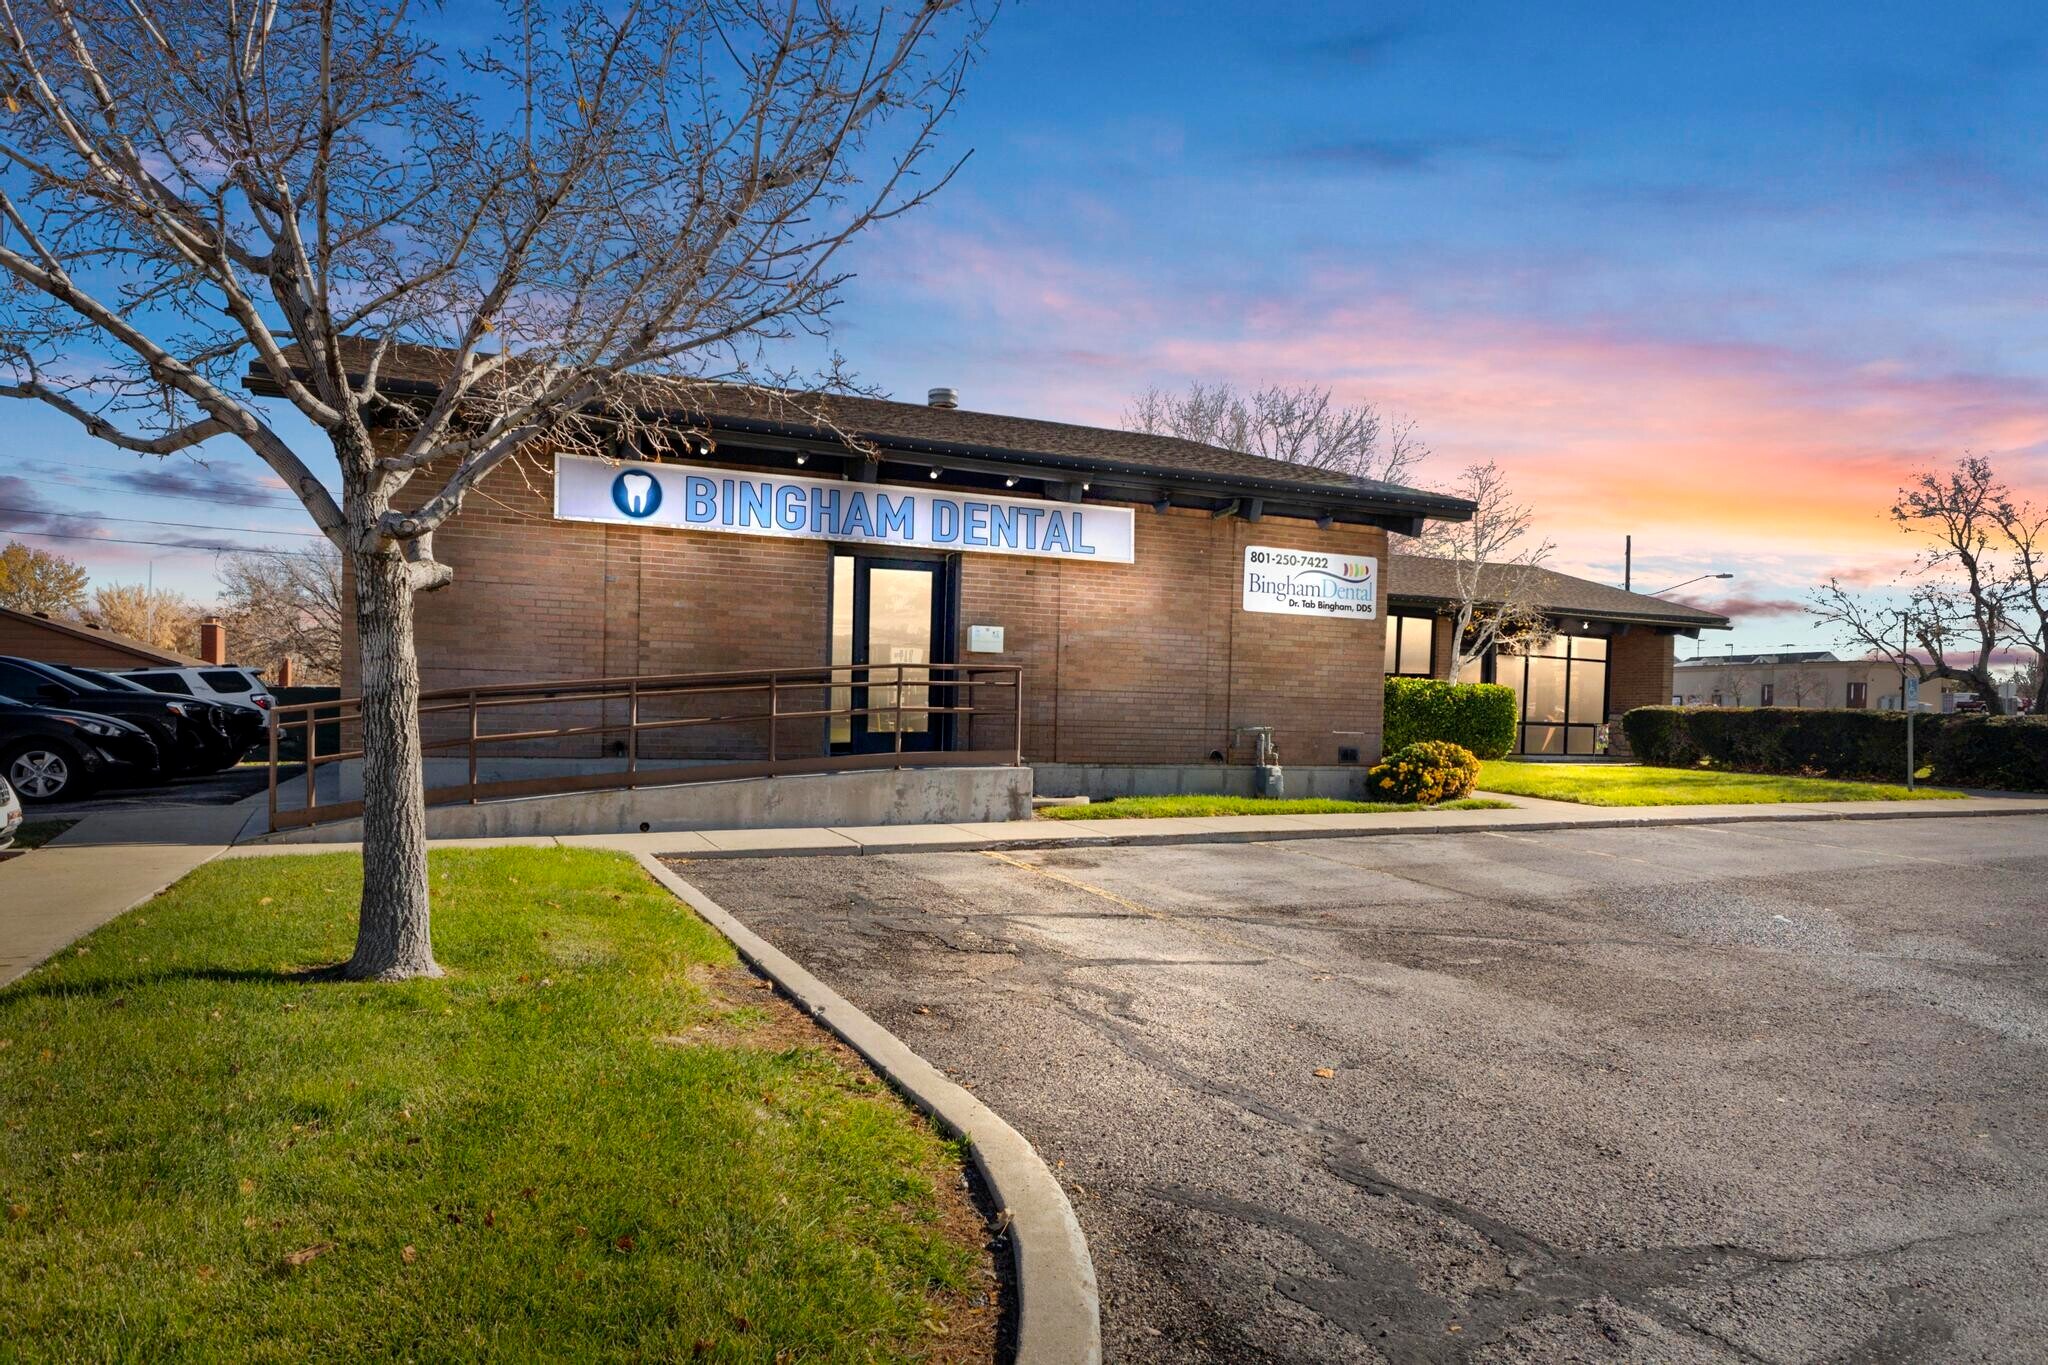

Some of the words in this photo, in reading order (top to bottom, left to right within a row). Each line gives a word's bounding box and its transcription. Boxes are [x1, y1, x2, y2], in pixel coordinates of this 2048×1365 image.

[685, 475, 915, 540] BINGHAM
[931, 498, 1096, 554] DENTAL
[1250, 551, 1328, 569] 801-250-7422
[1288, 598, 1300, 608] Dr.
[1302, 599, 1316, 610] Tab
[1317, 601, 1354, 613] Bingham,
[1356, 603, 1372, 613] DDS
